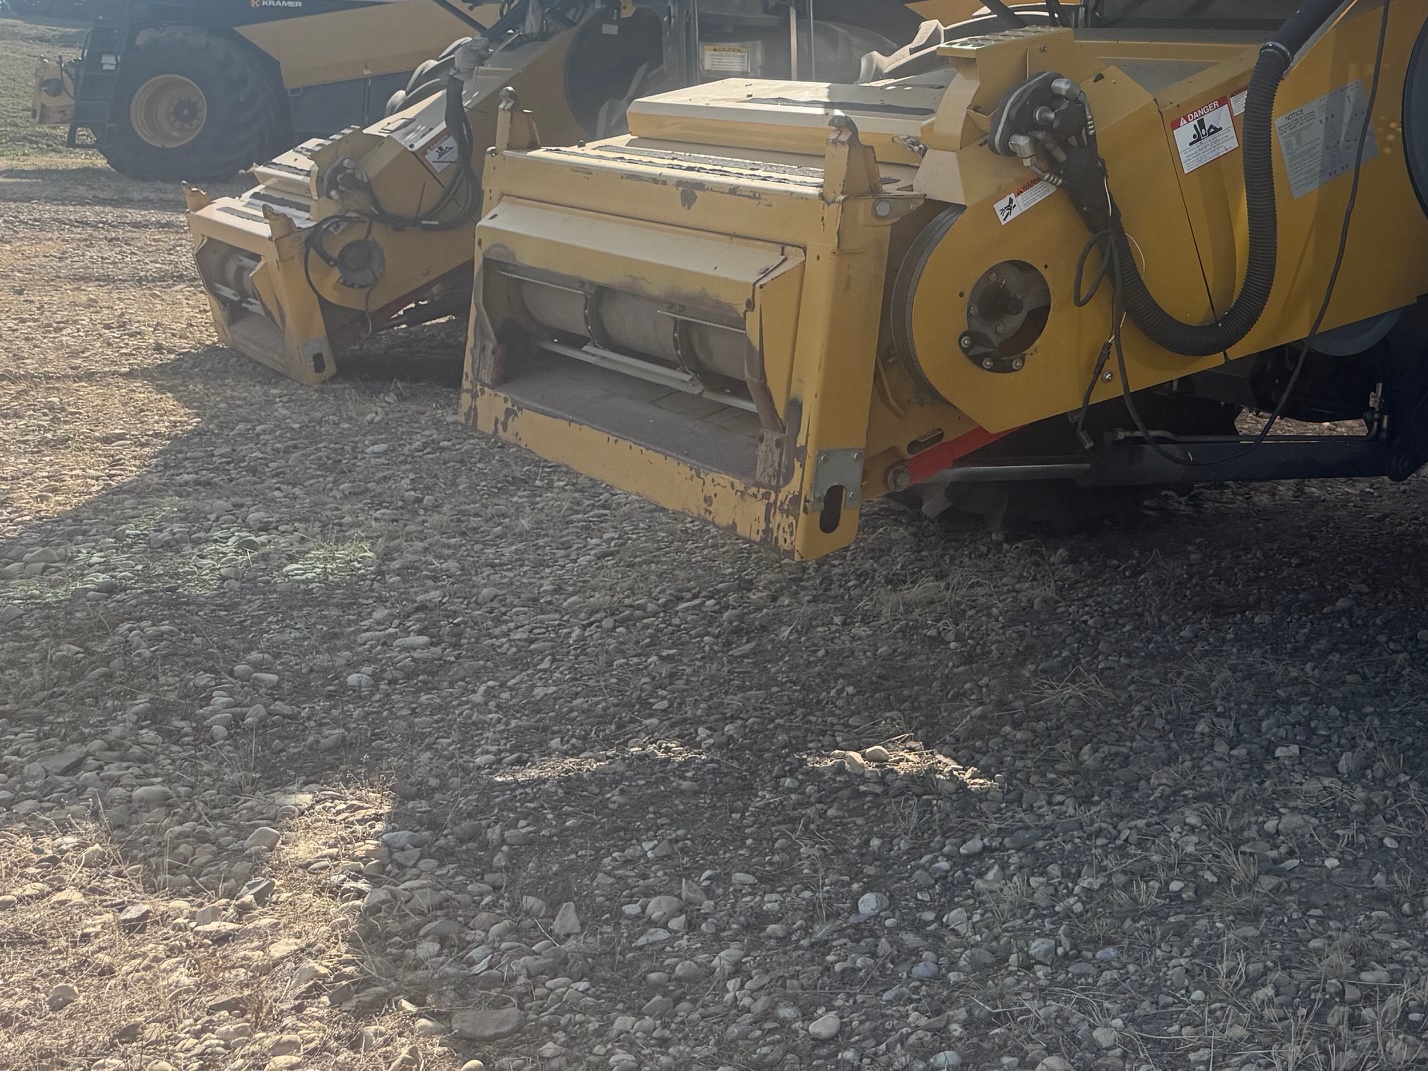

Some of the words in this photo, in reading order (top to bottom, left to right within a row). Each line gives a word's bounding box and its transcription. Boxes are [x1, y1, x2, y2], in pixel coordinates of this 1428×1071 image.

[261, 0, 302, 8] KRAMER
[1187, 100, 1220, 122] DANGER
[1284, 108, 1304, 122] NOTICE
